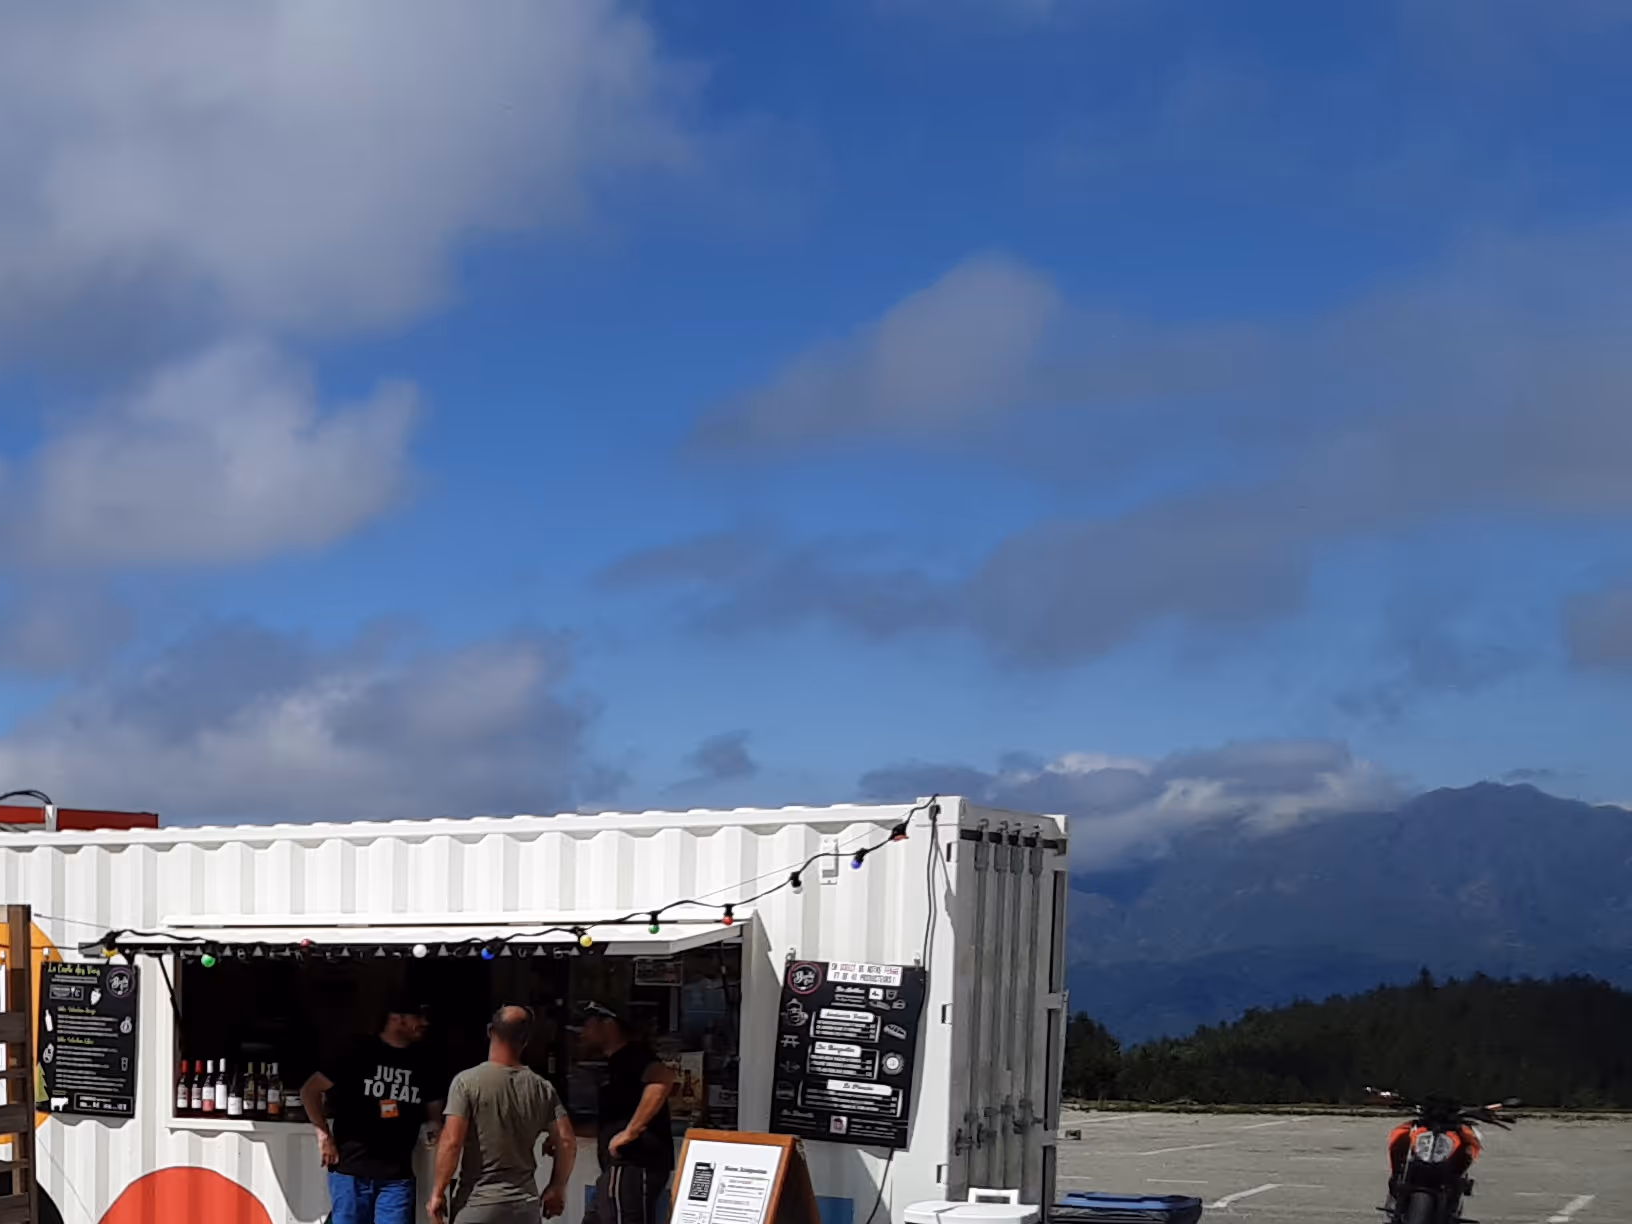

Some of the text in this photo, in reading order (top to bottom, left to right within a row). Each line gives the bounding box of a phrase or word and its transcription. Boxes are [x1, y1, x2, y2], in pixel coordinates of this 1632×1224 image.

[373, 1064, 412, 1086] JUST
[363, 1079, 421, 1104] TO EAT.
